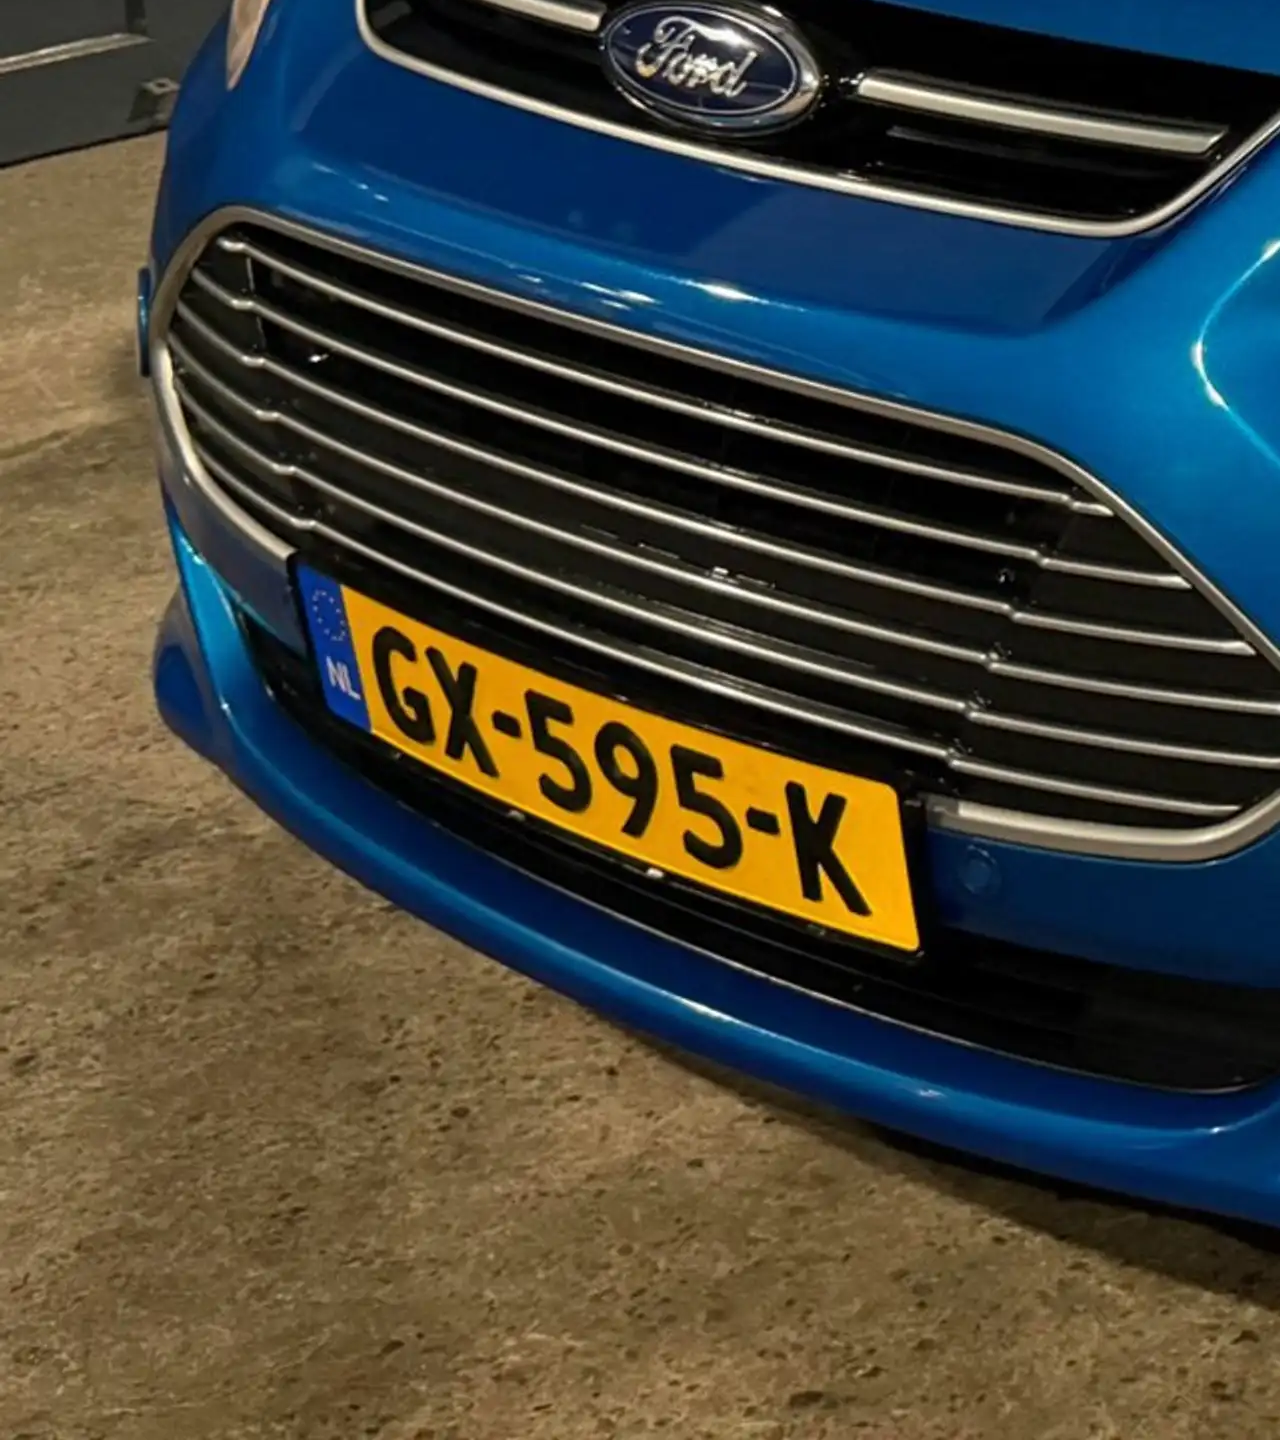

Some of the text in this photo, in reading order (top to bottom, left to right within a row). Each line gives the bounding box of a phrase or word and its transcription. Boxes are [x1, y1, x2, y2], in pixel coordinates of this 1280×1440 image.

[635, 15, 759, 98] Ford
[326, 657, 363, 702] NL
[371, 624, 873, 918] GX-595-K
